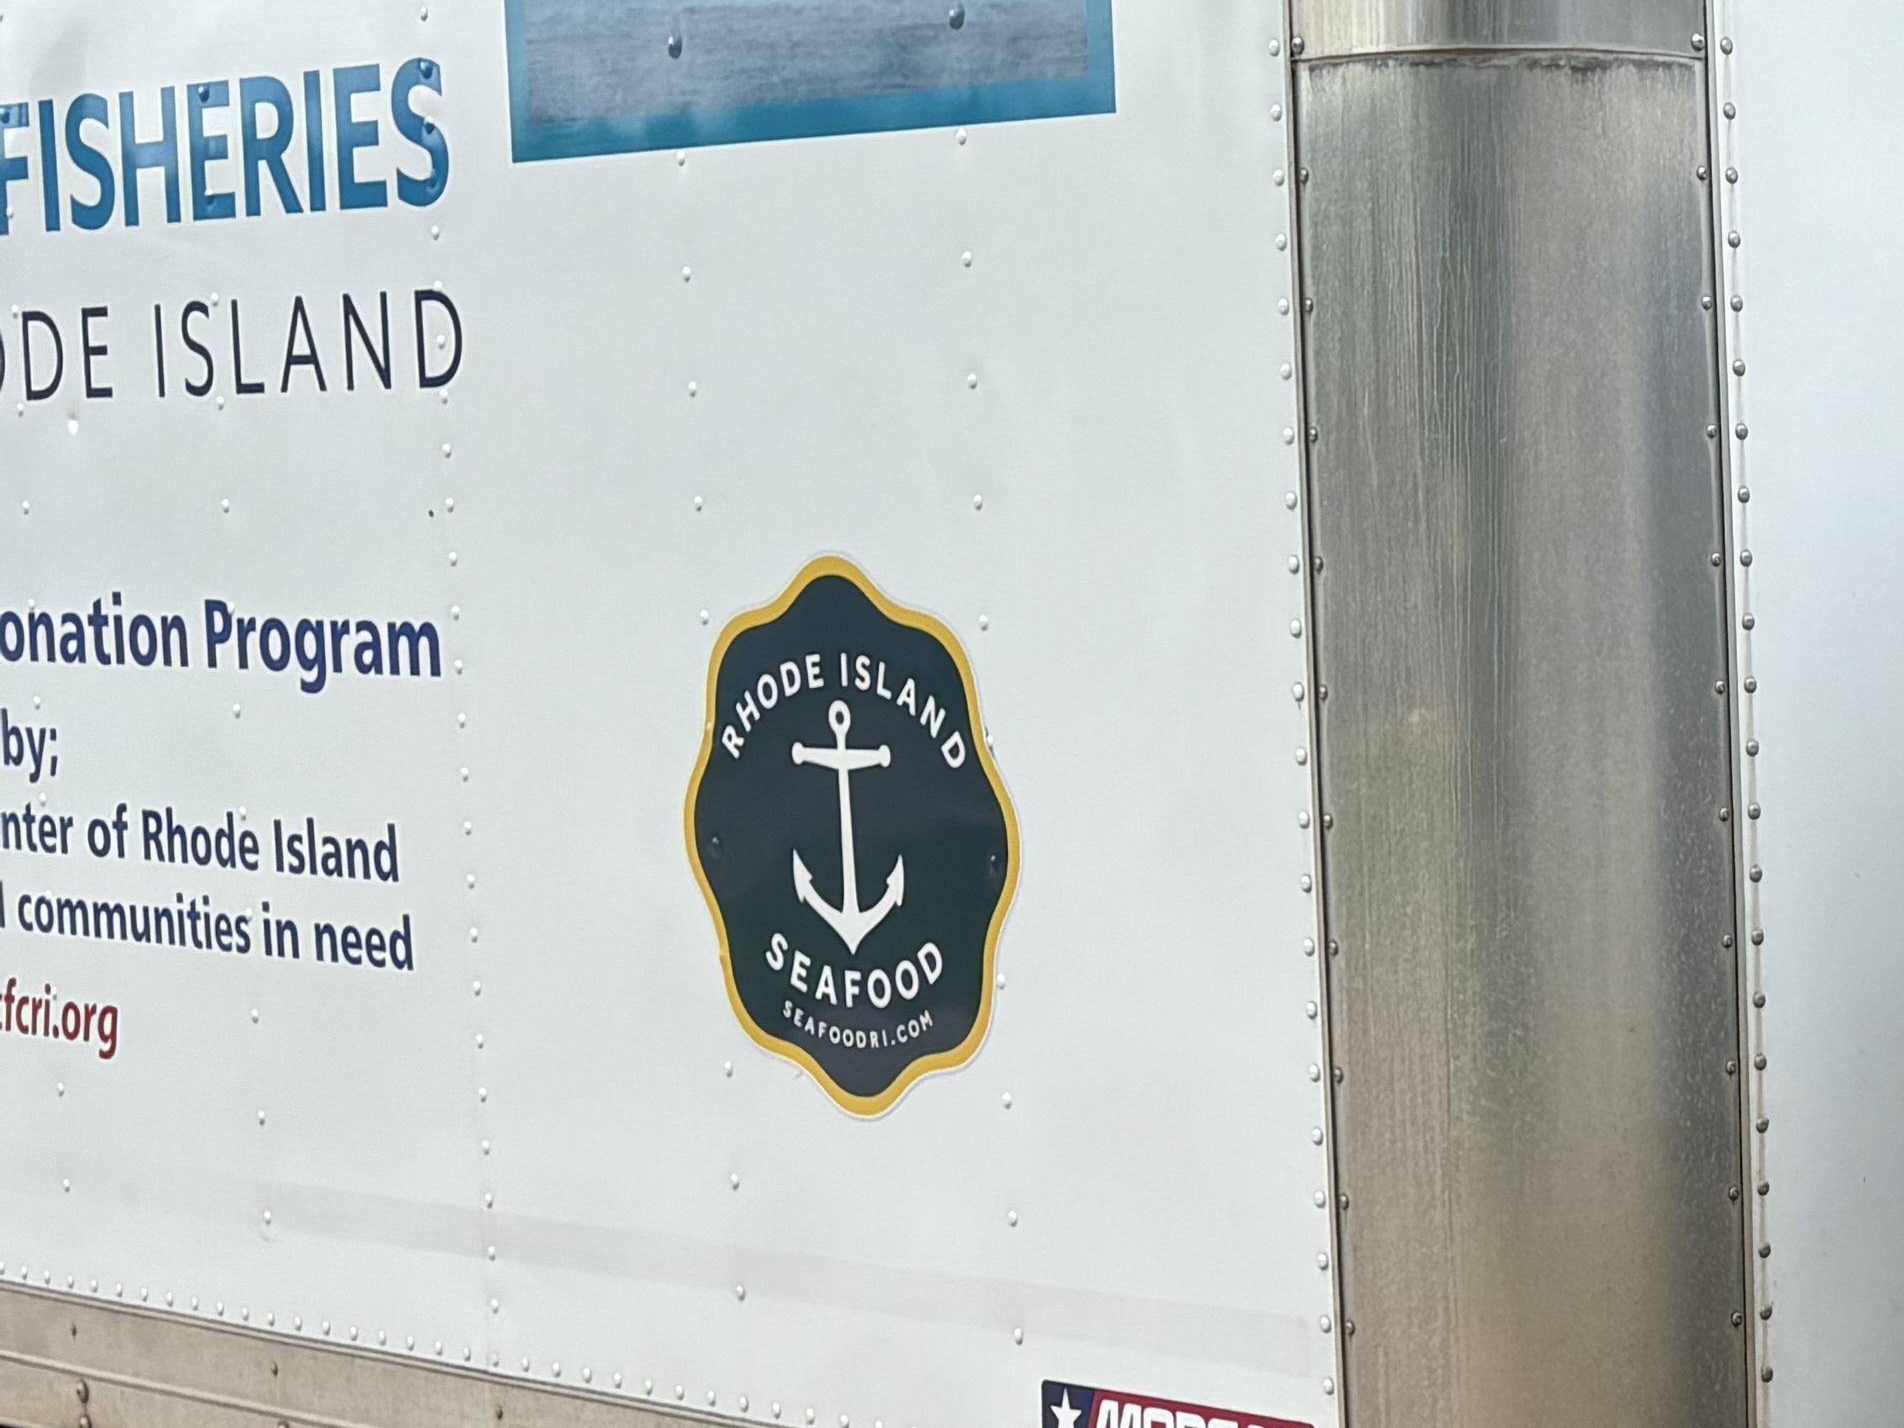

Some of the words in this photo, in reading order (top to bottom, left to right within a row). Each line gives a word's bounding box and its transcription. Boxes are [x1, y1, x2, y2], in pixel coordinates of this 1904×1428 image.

[0, 56, 450, 233] FISHERIES
[0, 305, 113, 401] DE
[153, 288, 463, 398] ISLAND
[0, 592, 189, 668] onation
[204, 598, 441, 694] Program
[1, 708, 59, 783] by;
[721, 653, 826, 759] RHODE
[839, 652, 966, 769] ISLAND
[1, 803, 74, 855] nter
[88, 803, 128, 859] of
[142, 807, 259, 872] Rhode
[274, 817, 400, 883] Island
[18, 892, 251, 954] communities
[262, 901, 299, 960] in
[314, 914, 414, 971] need
[765, 933, 943, 1009] SEAFOOD
[0, 978, 118, 1060] fcri.org
[782, 1000, 934, 1049] SEAFOODRI.COM
